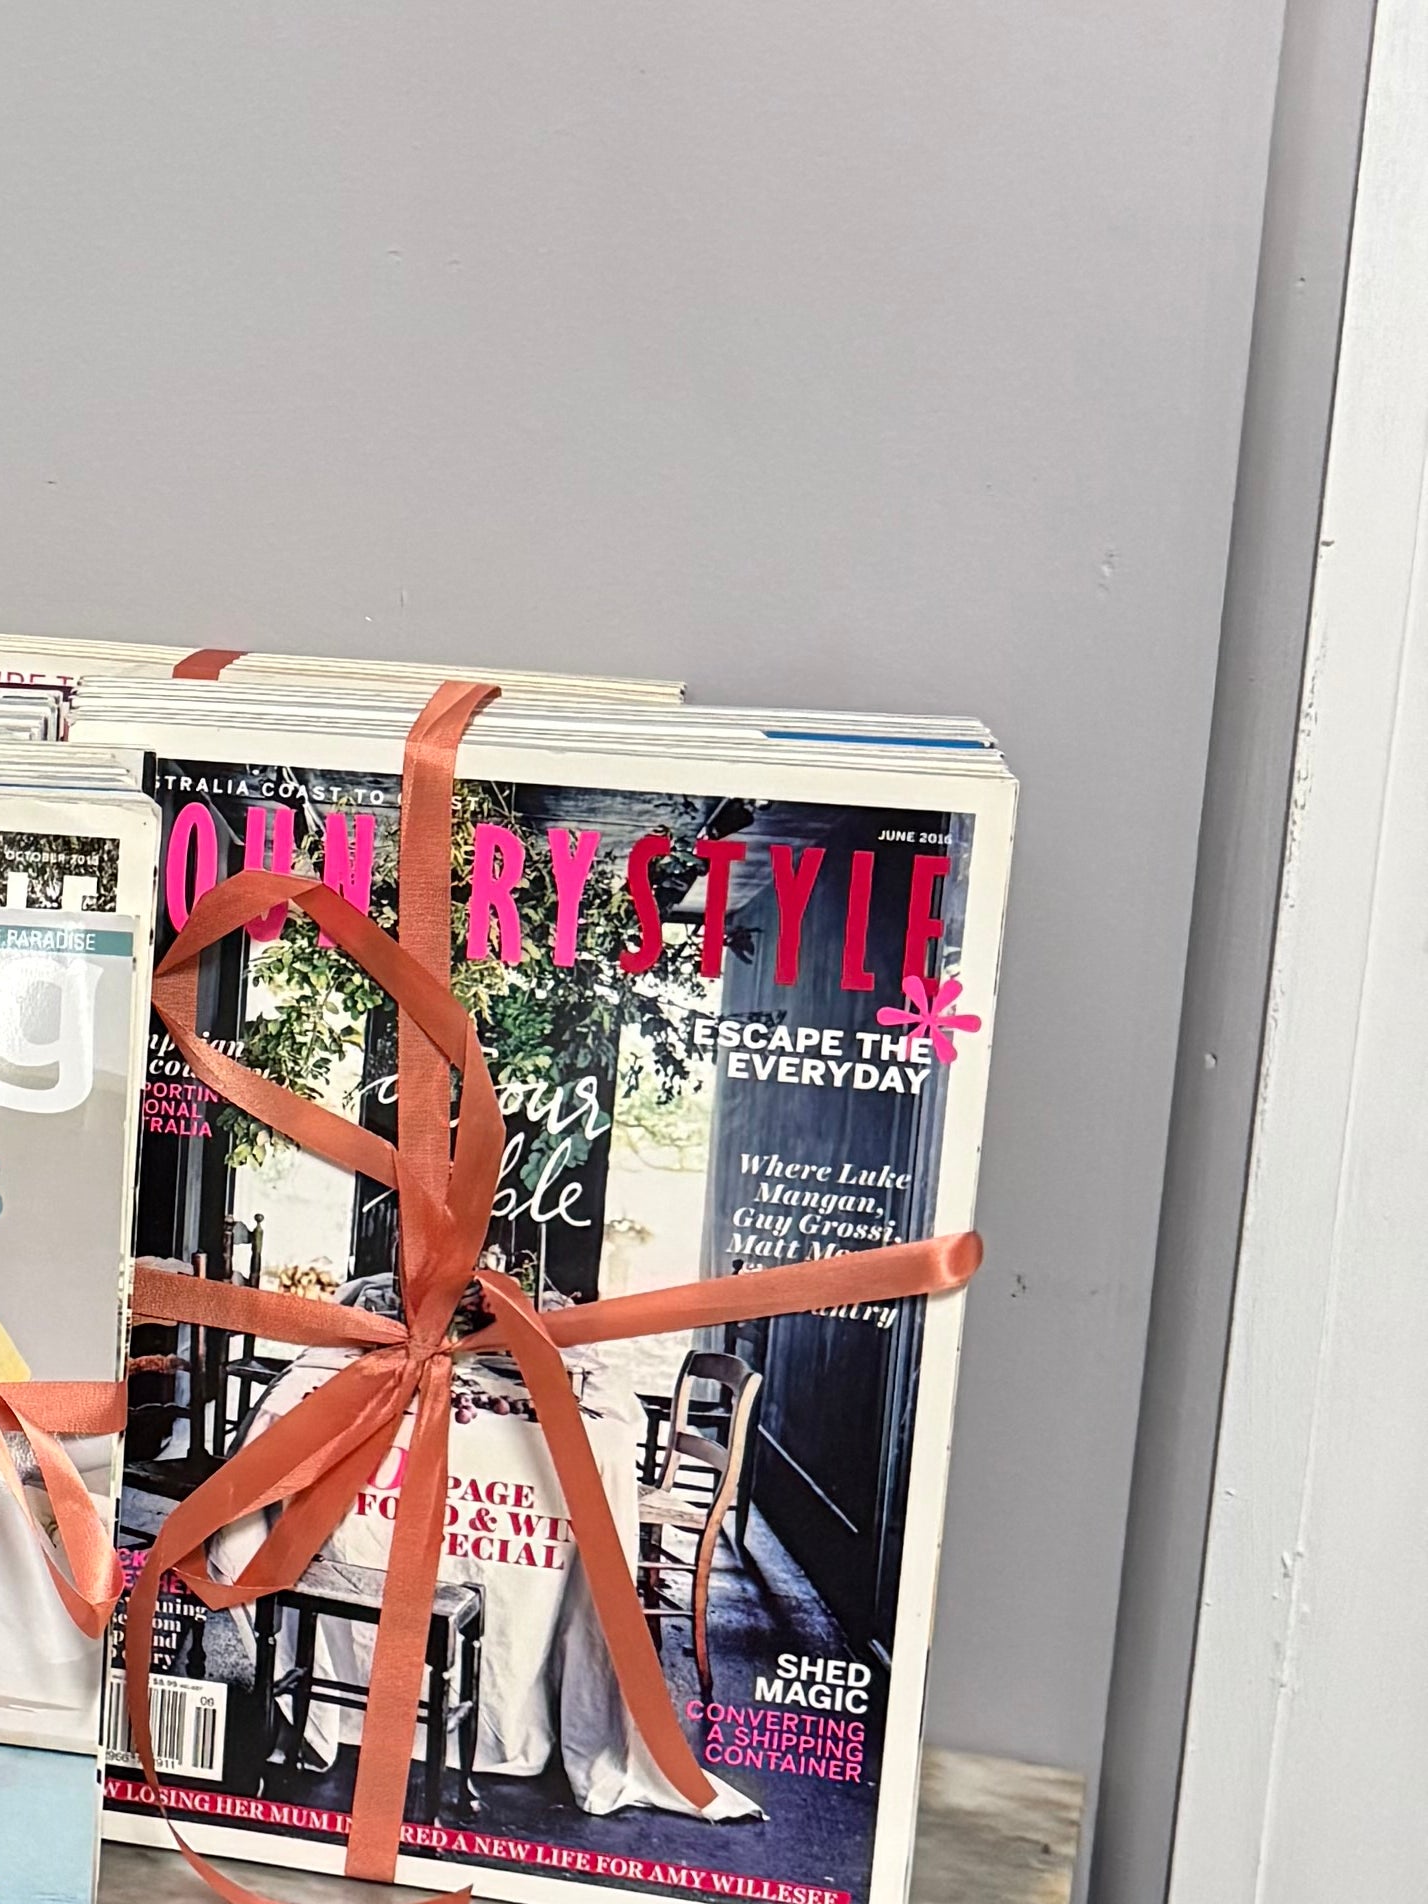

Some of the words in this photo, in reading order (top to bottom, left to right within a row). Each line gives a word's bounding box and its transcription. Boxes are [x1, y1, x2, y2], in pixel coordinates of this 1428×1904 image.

[166, 801, 600, 967] OUNRY
[618, 833, 950, 997] STYLE
[6, 930, 96, 951] PARADISE
[694, 1018, 845, 1057] ESCAPE
[856, 1032, 933, 1065] THE
[727, 1052, 930, 1095] EVERYDAY
[740, 1154, 832, 1182] Where
[837, 1163, 912, 1190] Luke
[754, 1182, 885, 1218] Mangan,
[733, 1207, 793, 1237] Guy
[776, 1653, 871, 1688] SHED
[755, 1676, 869, 1714] MAGIC
[686, 1700, 865, 1742] CONVERTING
[705, 1743, 862, 1783] CONTAINER
[735, 1726, 863, 1762] SHIPPING
[126, 1786, 210, 1811] LOSING
[475, 1836, 530, 1861] NEW
[536, 1846, 591, 1871] LIFE
[595, 1855, 644, 1879] FOR
[648, 1865, 706, 1889] AMY
